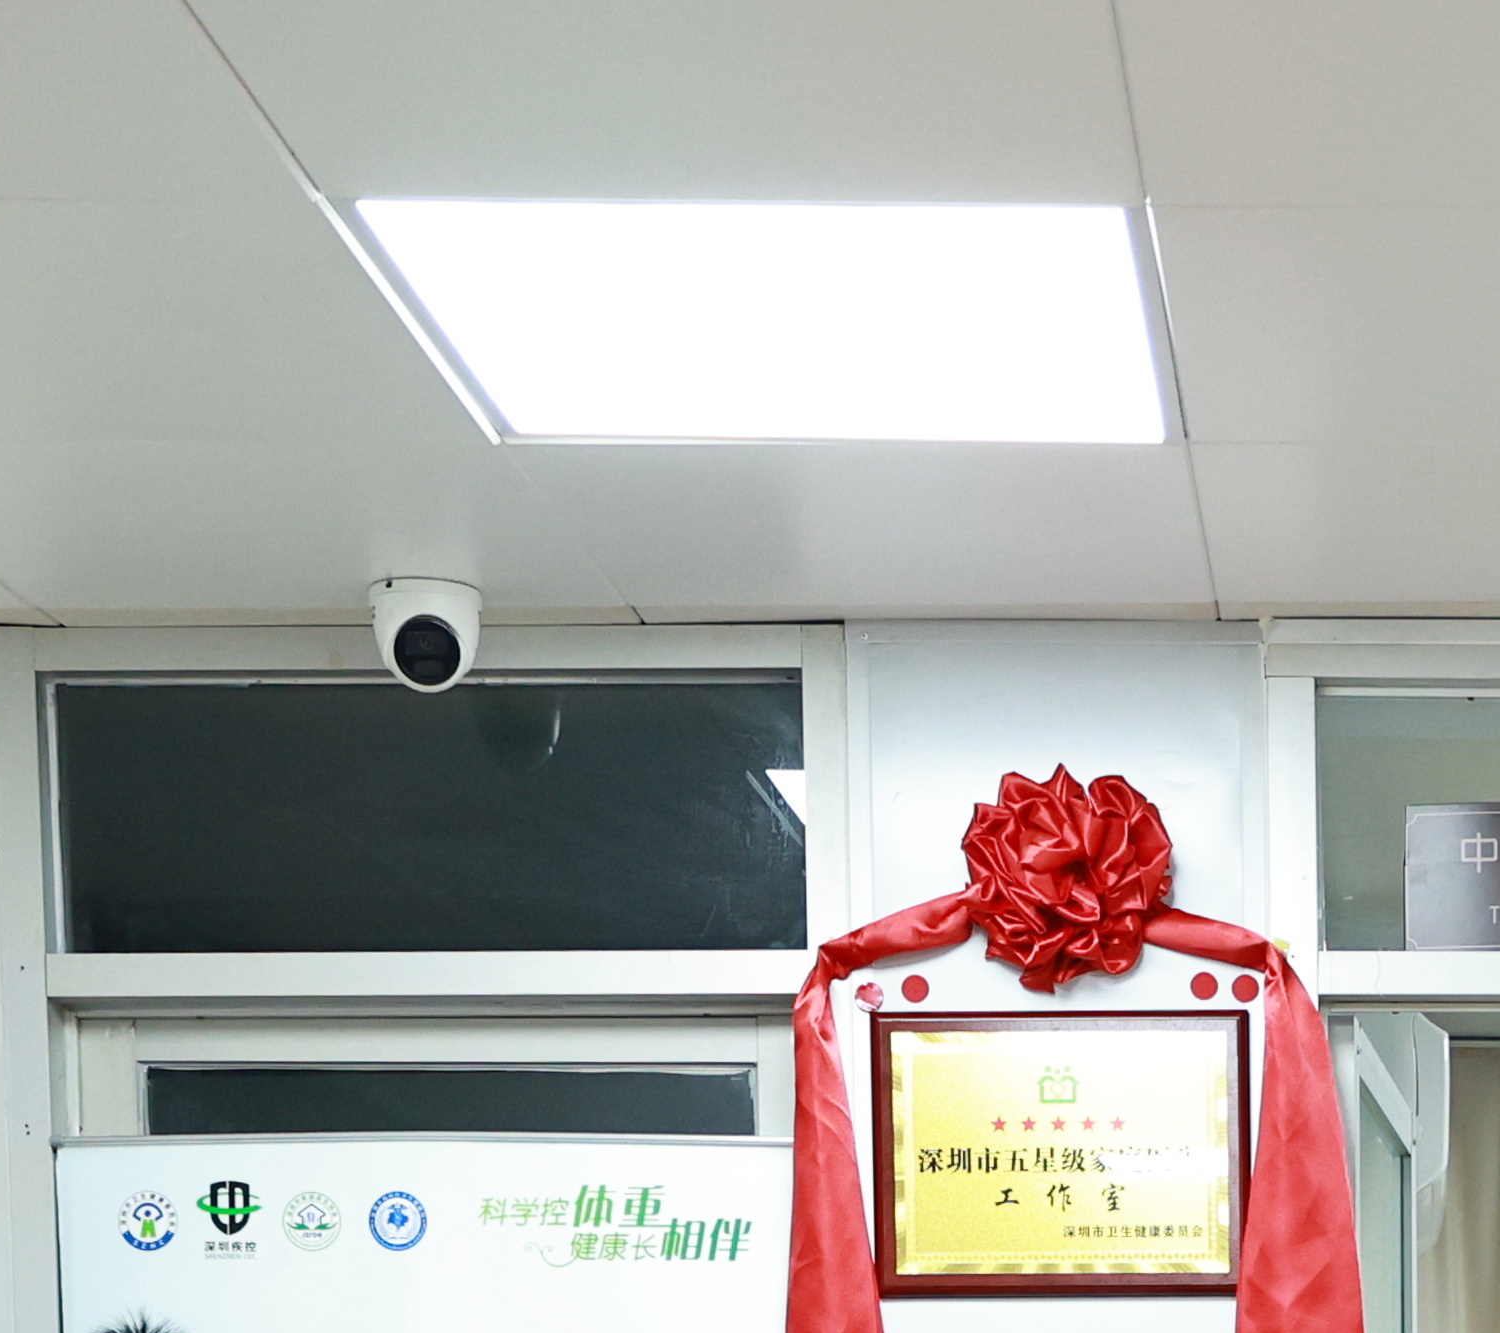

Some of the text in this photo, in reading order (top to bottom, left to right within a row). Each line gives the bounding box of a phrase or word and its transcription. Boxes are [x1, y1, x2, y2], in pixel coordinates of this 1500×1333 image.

[918, 1146, 1192, 1175] 深圳市五星级家
[478, 1184, 670, 1227] 科学控体重
[994, 1182, 1126, 1212] 工作室
[570, 1218, 752, 1261] 健康长相伴
[1062, 1224, 1204, 1239] 深圳市卫生健康委员会
[204, 1241, 257, 1252] 深圳疾控
